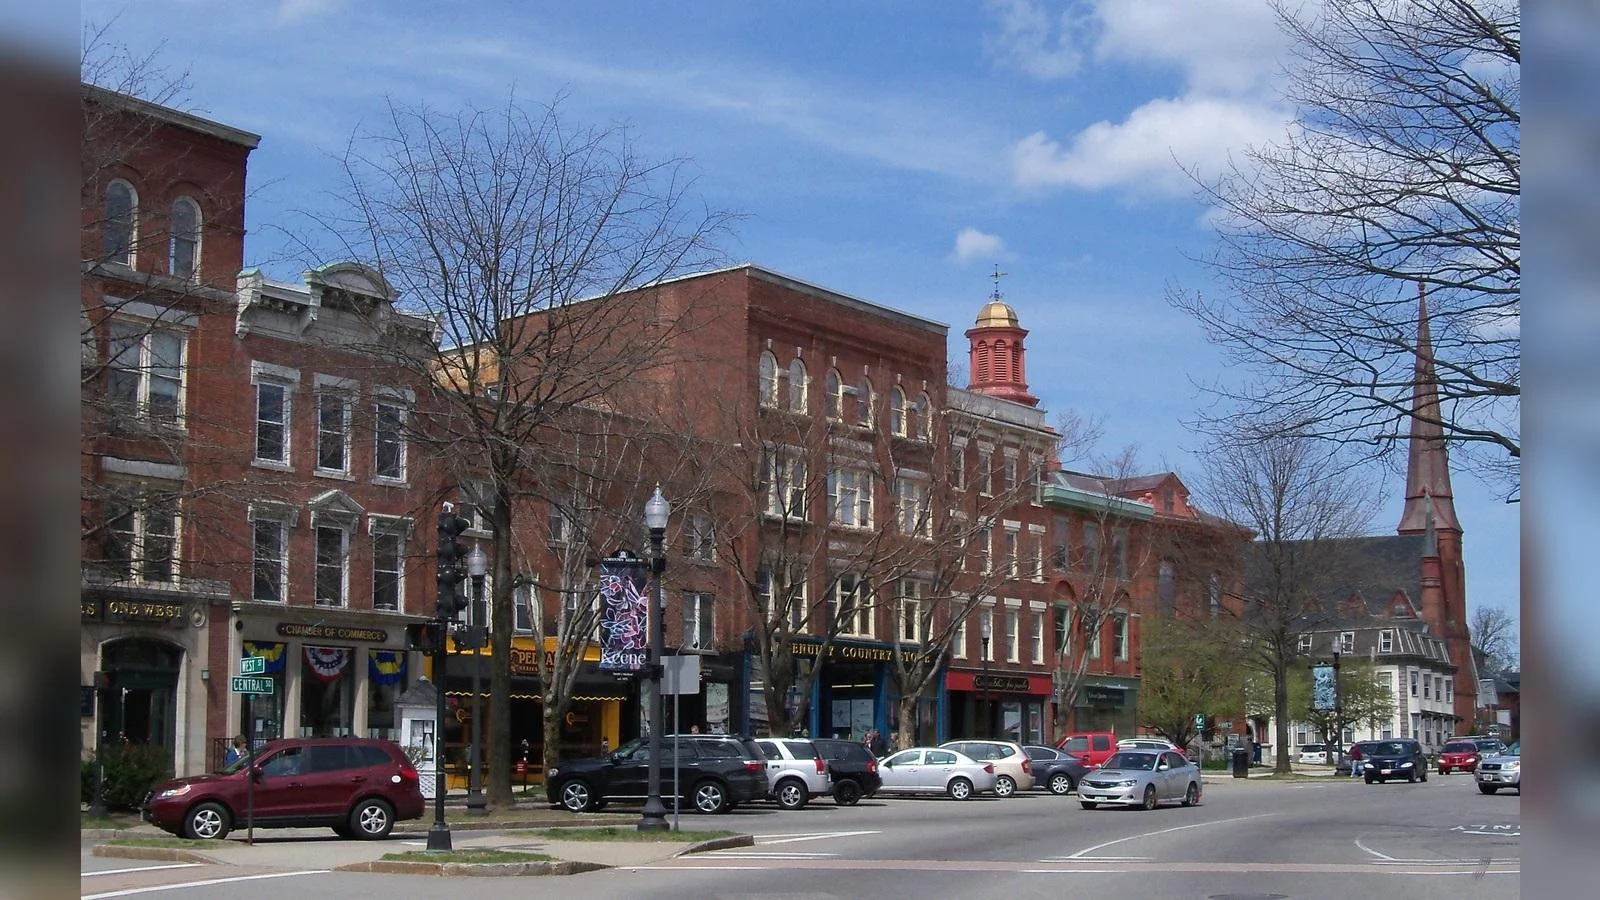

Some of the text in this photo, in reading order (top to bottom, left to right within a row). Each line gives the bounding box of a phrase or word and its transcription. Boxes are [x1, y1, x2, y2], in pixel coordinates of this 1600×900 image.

[109, 601, 182, 618] ONE WEST
[286, 625, 382, 640] CHAMBER OF COMMERCE
[600, 647, 646, 665] Keene
[842, 646, 892, 661] COUNTRY
[241, 659, 255, 672] WEST
[233, 678, 265, 691] CENTRAL
